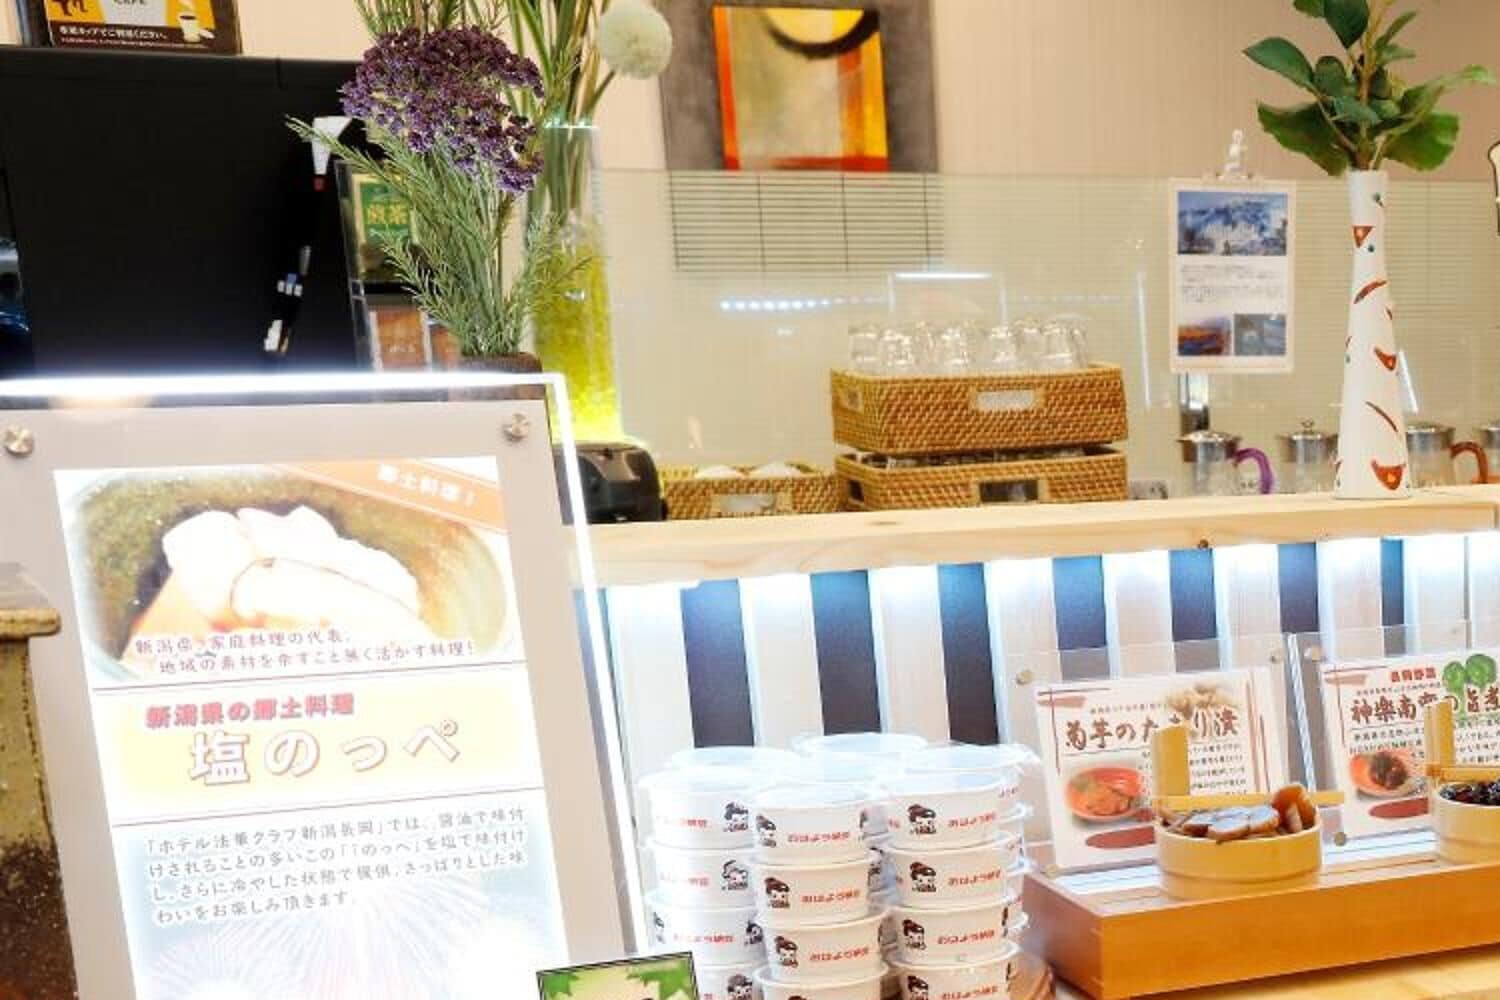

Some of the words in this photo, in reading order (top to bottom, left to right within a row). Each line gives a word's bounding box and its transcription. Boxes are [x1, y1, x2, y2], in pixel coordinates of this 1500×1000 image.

[146, 694, 356, 729] 新潟県の郷土料理
[188, 719, 462, 785] 塩のっぺ
